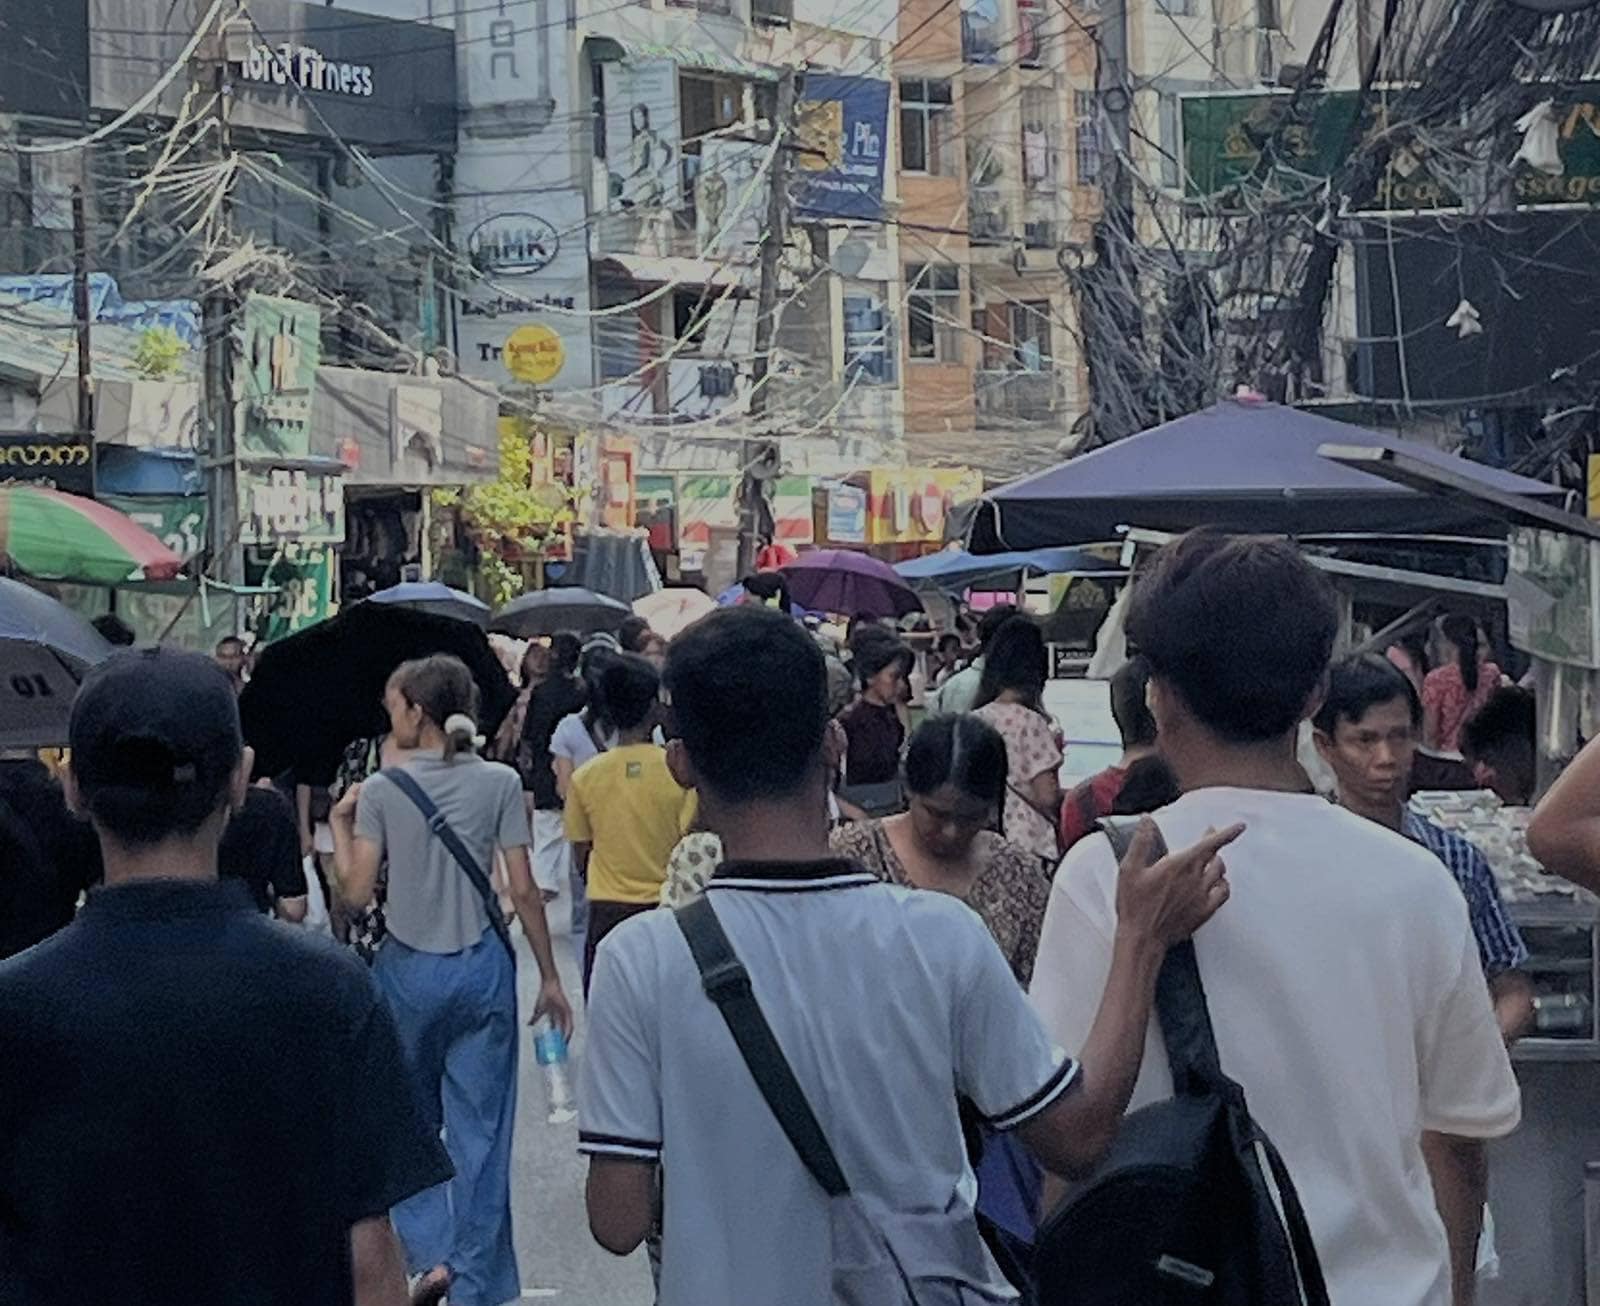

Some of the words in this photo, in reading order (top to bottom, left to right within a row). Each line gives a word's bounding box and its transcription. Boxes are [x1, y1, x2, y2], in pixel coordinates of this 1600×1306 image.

[300, 46, 373, 96] Fitness
[476, 343, 504, 361] Tr
[9, 674, 54, 699] 01
